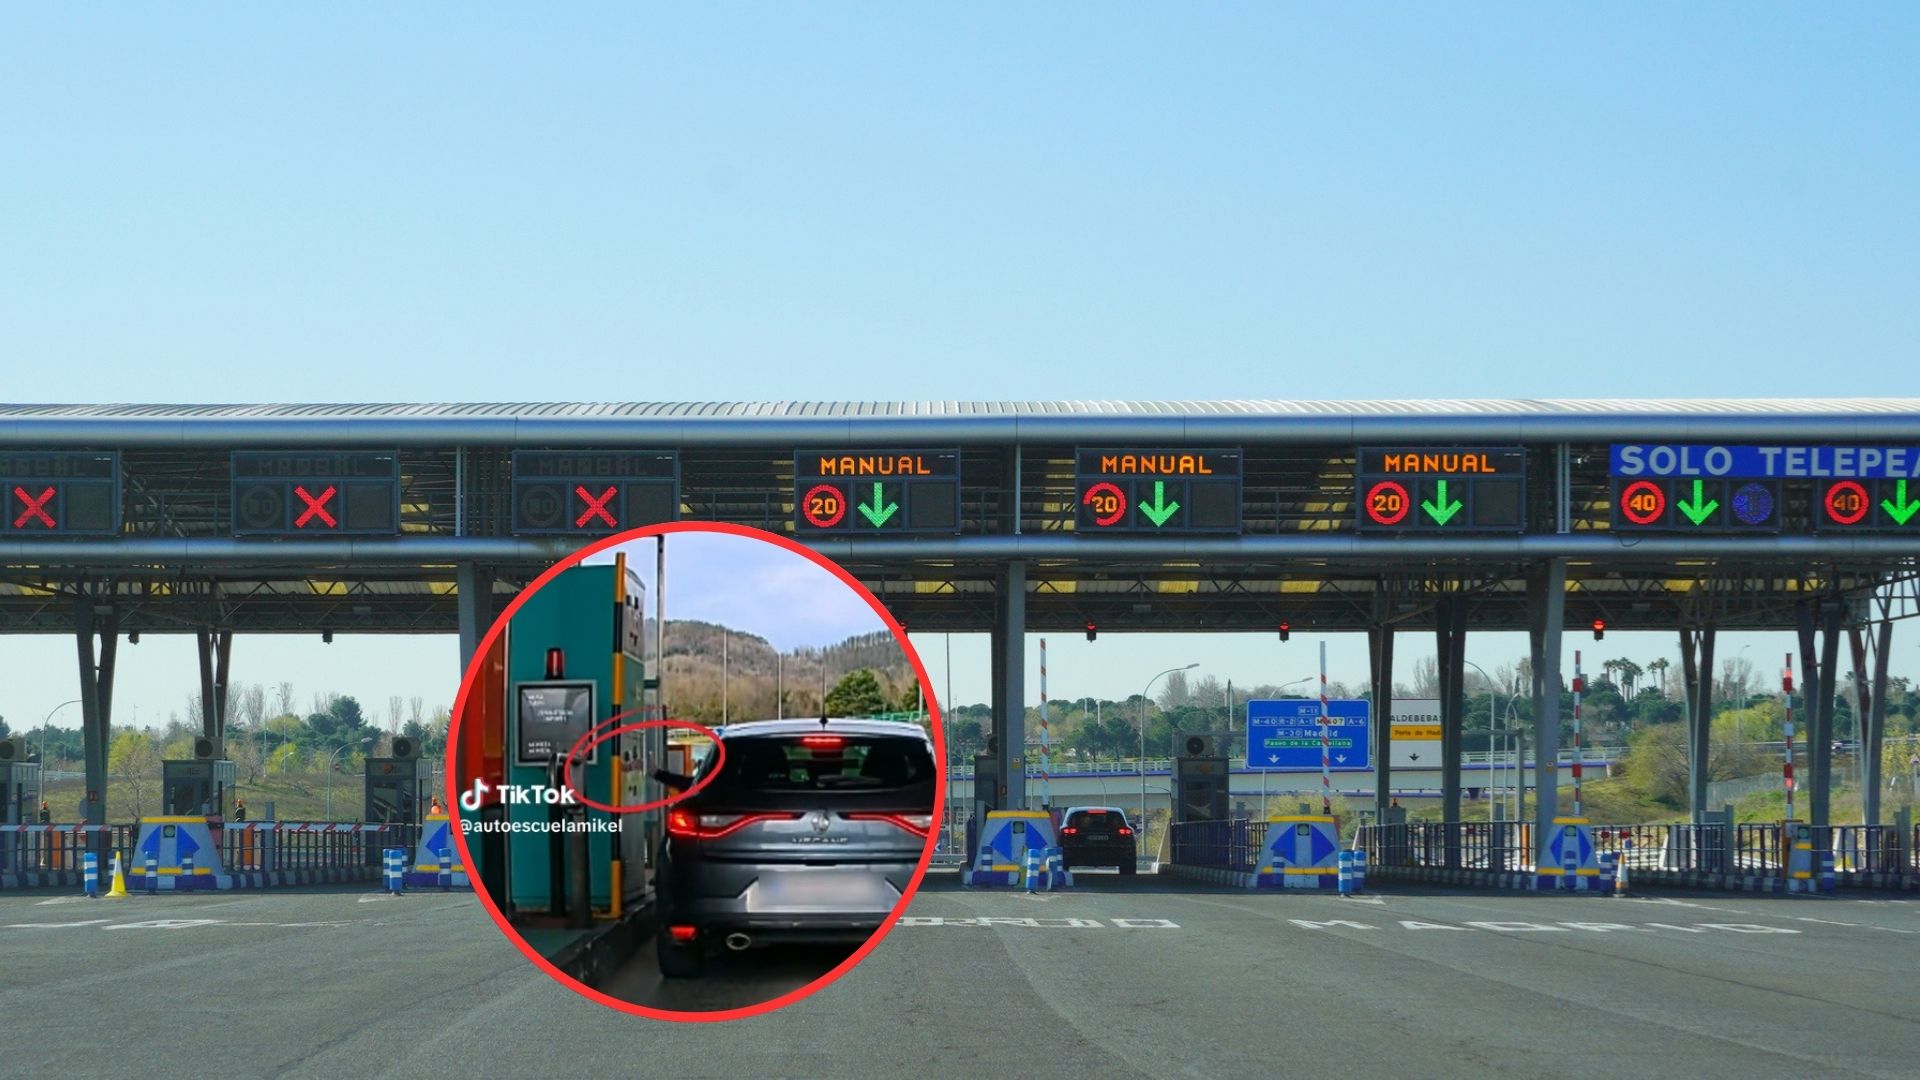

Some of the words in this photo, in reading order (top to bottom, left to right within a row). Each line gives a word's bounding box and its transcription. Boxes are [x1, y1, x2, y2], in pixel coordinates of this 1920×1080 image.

[820, 456, 931, 476] MANUAL
[1102, 455, 1212, 474] MANUAL
[1384, 453, 1495, 473] MANUAL
[1619, 445, 1732, 475] SOLO
[811, 497, 838, 516] 20
[1092, 495, 1118, 513] 20
[1373, 494, 1401, 512] 20
[1629, 494, 1657, 512] 40
[1832, 494, 1862, 512] 40
[1391, 714, 1441, 722] ALDEBEBA
[1287, 918, 1803, 933] MADRID
